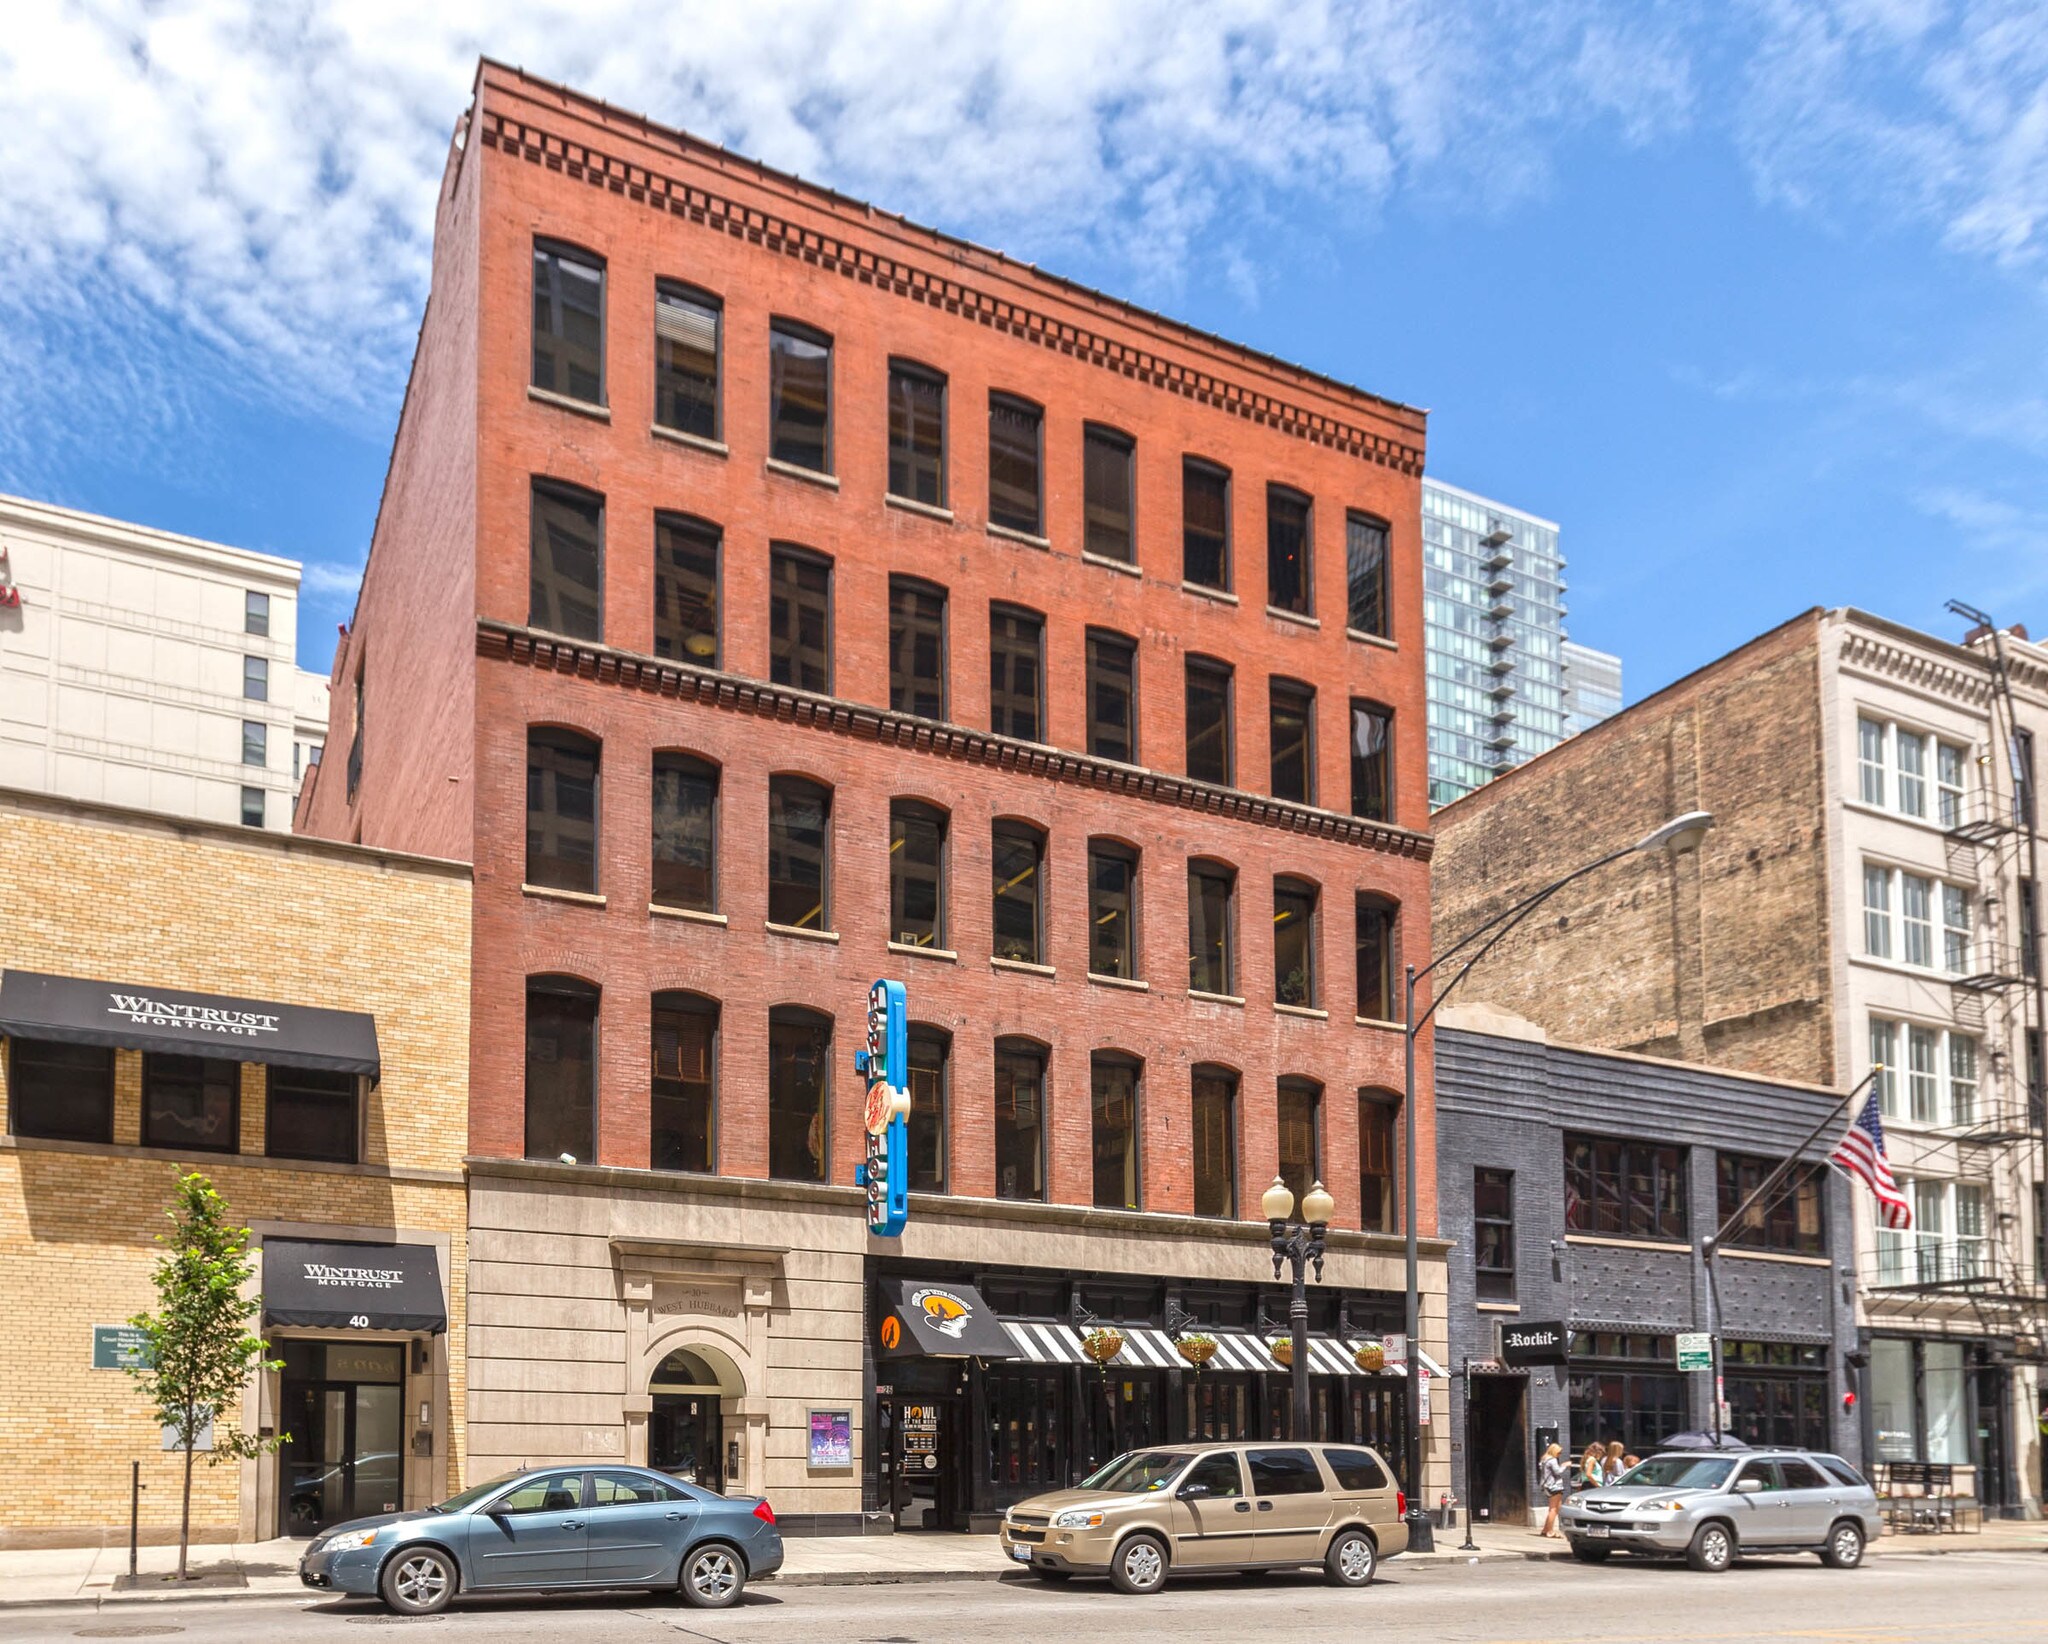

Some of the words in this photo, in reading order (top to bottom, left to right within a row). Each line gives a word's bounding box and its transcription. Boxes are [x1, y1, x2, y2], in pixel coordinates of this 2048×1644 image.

[110, 993, 280, 1028] WINTRUST
[130, 1014, 258, 1036] MORTGAGE
[867, 986, 888, 1079] HOWL
[303, 1263, 404, 1281] WINTRUST
[318, 1279, 392, 1289] MORTGAGE
[657, 1300, 684, 1315] WEST
[689, 1300, 738, 1318] HUBBARD
[349, 1315, 369, 1328] 40
[904, 1406, 937, 1419] HOWL
